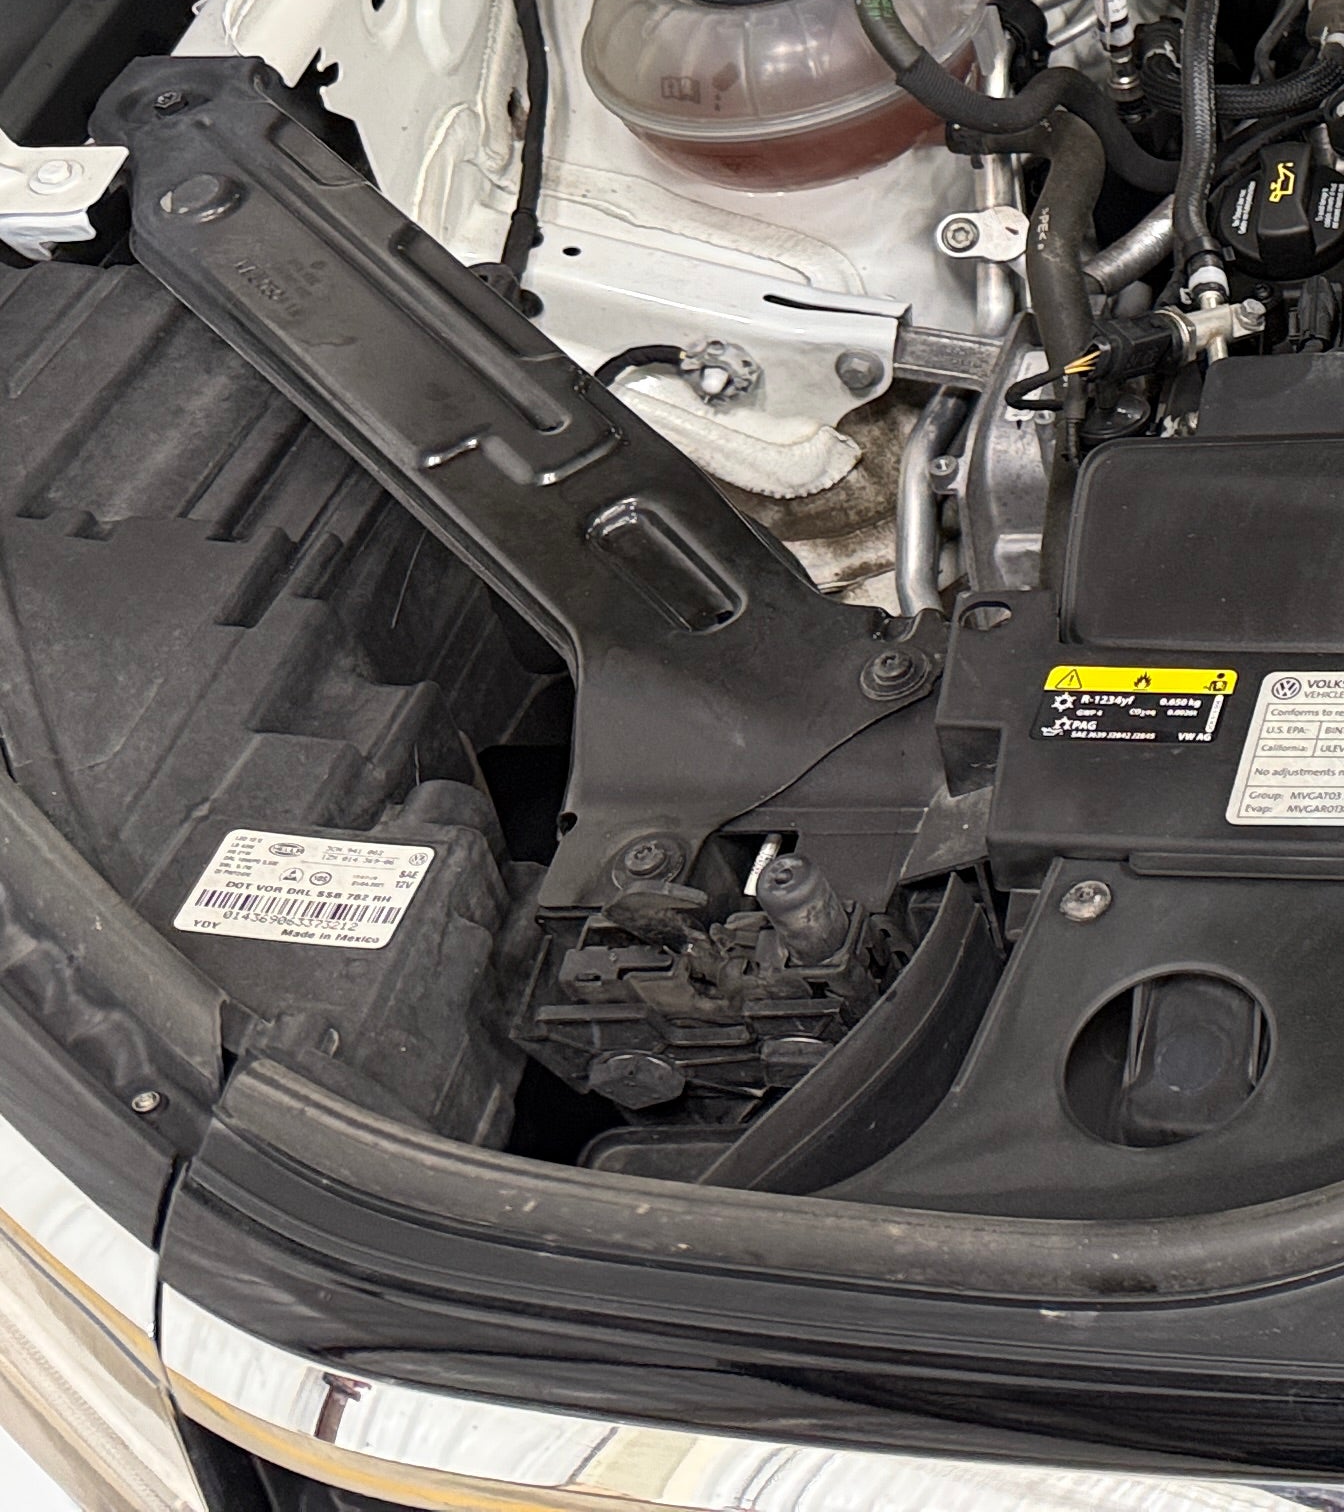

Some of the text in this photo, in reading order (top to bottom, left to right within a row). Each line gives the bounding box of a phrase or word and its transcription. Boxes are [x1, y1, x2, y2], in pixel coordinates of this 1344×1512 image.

[1304, 691, 1344, 699] VEHICLE
[1081, 694, 1135, 707] R-1234yf
[1188, 698, 1201, 708] kg
[1271, 709, 1319, 717] Conforms
[1322, 709, 1333, 717] to
[1072, 720, 1097, 730] PAG
[1178, 732, 1212, 741] VW AG
[1261, 744, 1308, 752] California:
[1254, 768, 1270, 776] No
[1272, 768, 1336, 778] adjustments
[1249, 792, 1284, 801] Group:
[1245, 805, 1272, 814] Evap:
[399, 870, 419, 879] SAE
[395, 880, 415, 889] 12V
[226, 881, 253, 890] DOT
[256, 884, 283, 893] VOR
[287, 888, 312, 897] DRL
[372, 895, 392, 903] RH
[281, 929, 315, 939] Made
[335, 933, 380, 943] Mexico
